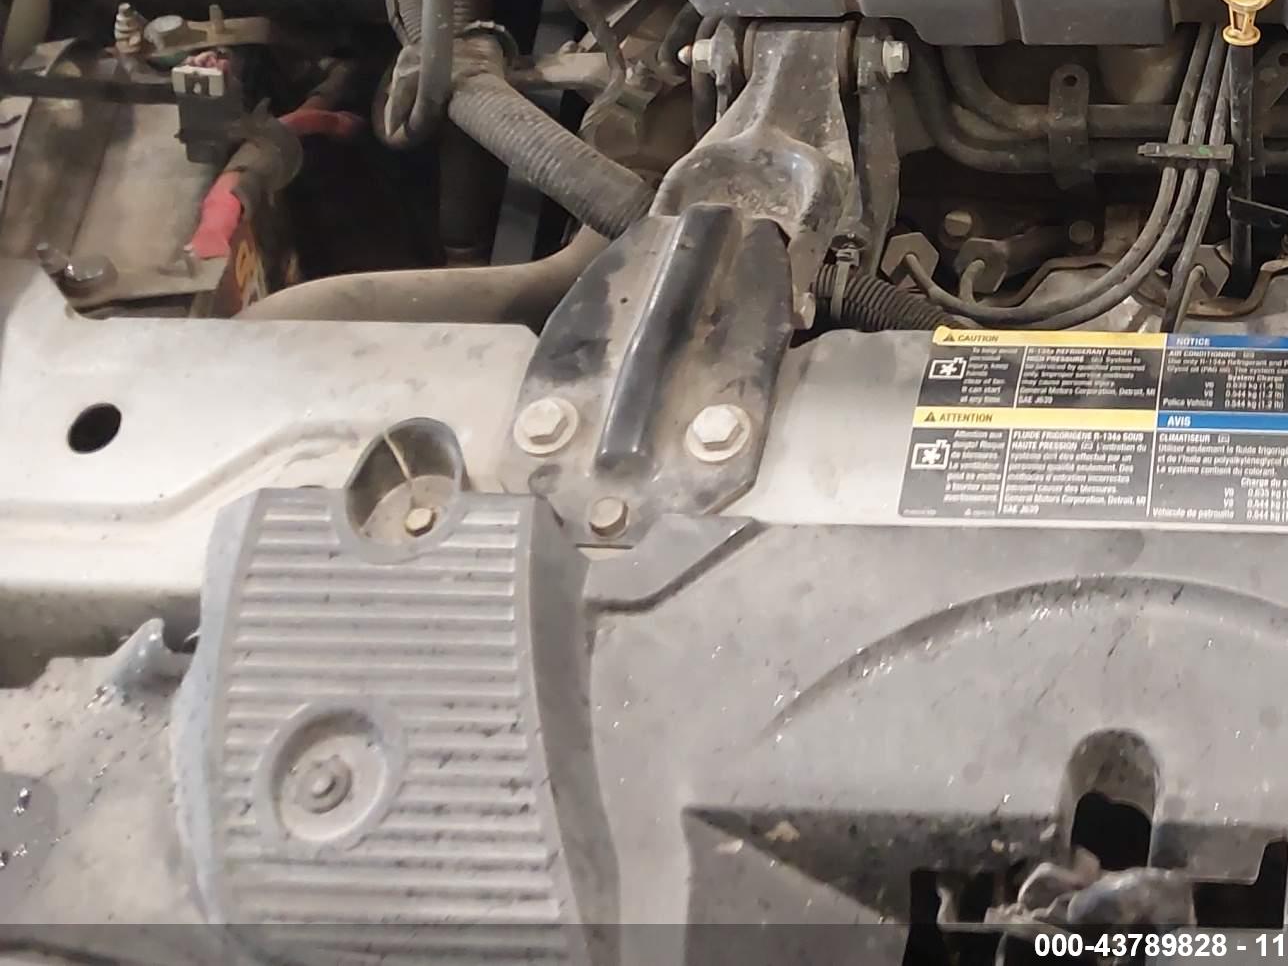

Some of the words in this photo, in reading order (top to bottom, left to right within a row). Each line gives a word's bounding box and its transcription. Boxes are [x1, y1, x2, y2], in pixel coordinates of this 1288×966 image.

[957, 334, 999, 343] CAUTION
[1176, 337, 1211, 347] NOTICE
[939, 412, 993, 423] ATTENTION
[1167, 415, 1192, 427] AVIS
[1159, 433, 1211, 443] CLIMATISEUR
